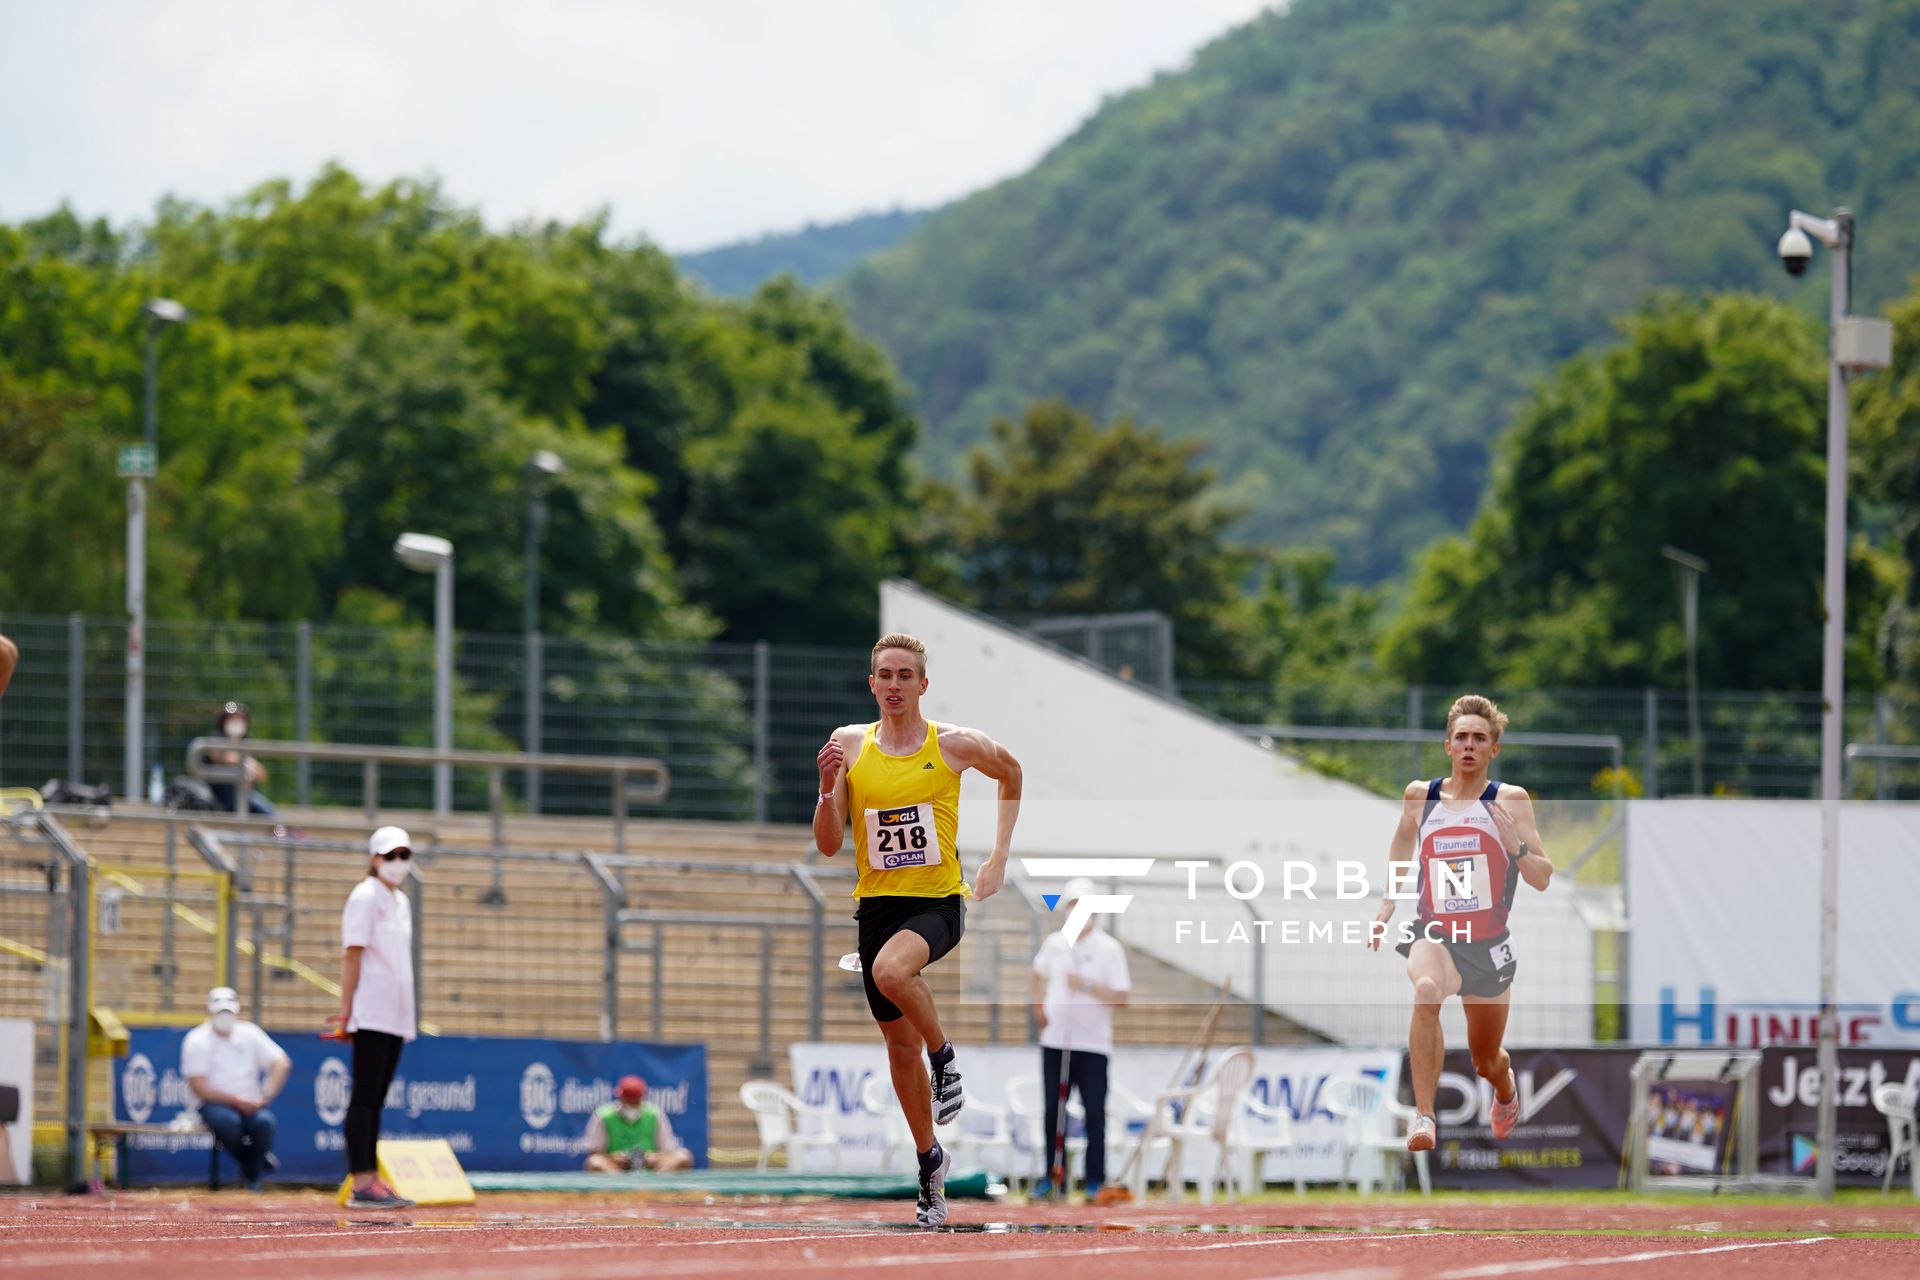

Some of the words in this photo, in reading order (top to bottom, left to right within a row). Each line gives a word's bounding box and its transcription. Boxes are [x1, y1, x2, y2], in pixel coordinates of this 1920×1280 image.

[900, 811, 916, 822] GLS
[877, 826, 927, 852] 218
[1434, 838, 1477, 851] Traumeel
[900, 852, 924, 862] PLAN
[1500, 944, 1513, 963] 3
[407, 1073, 476, 1118] gesund
